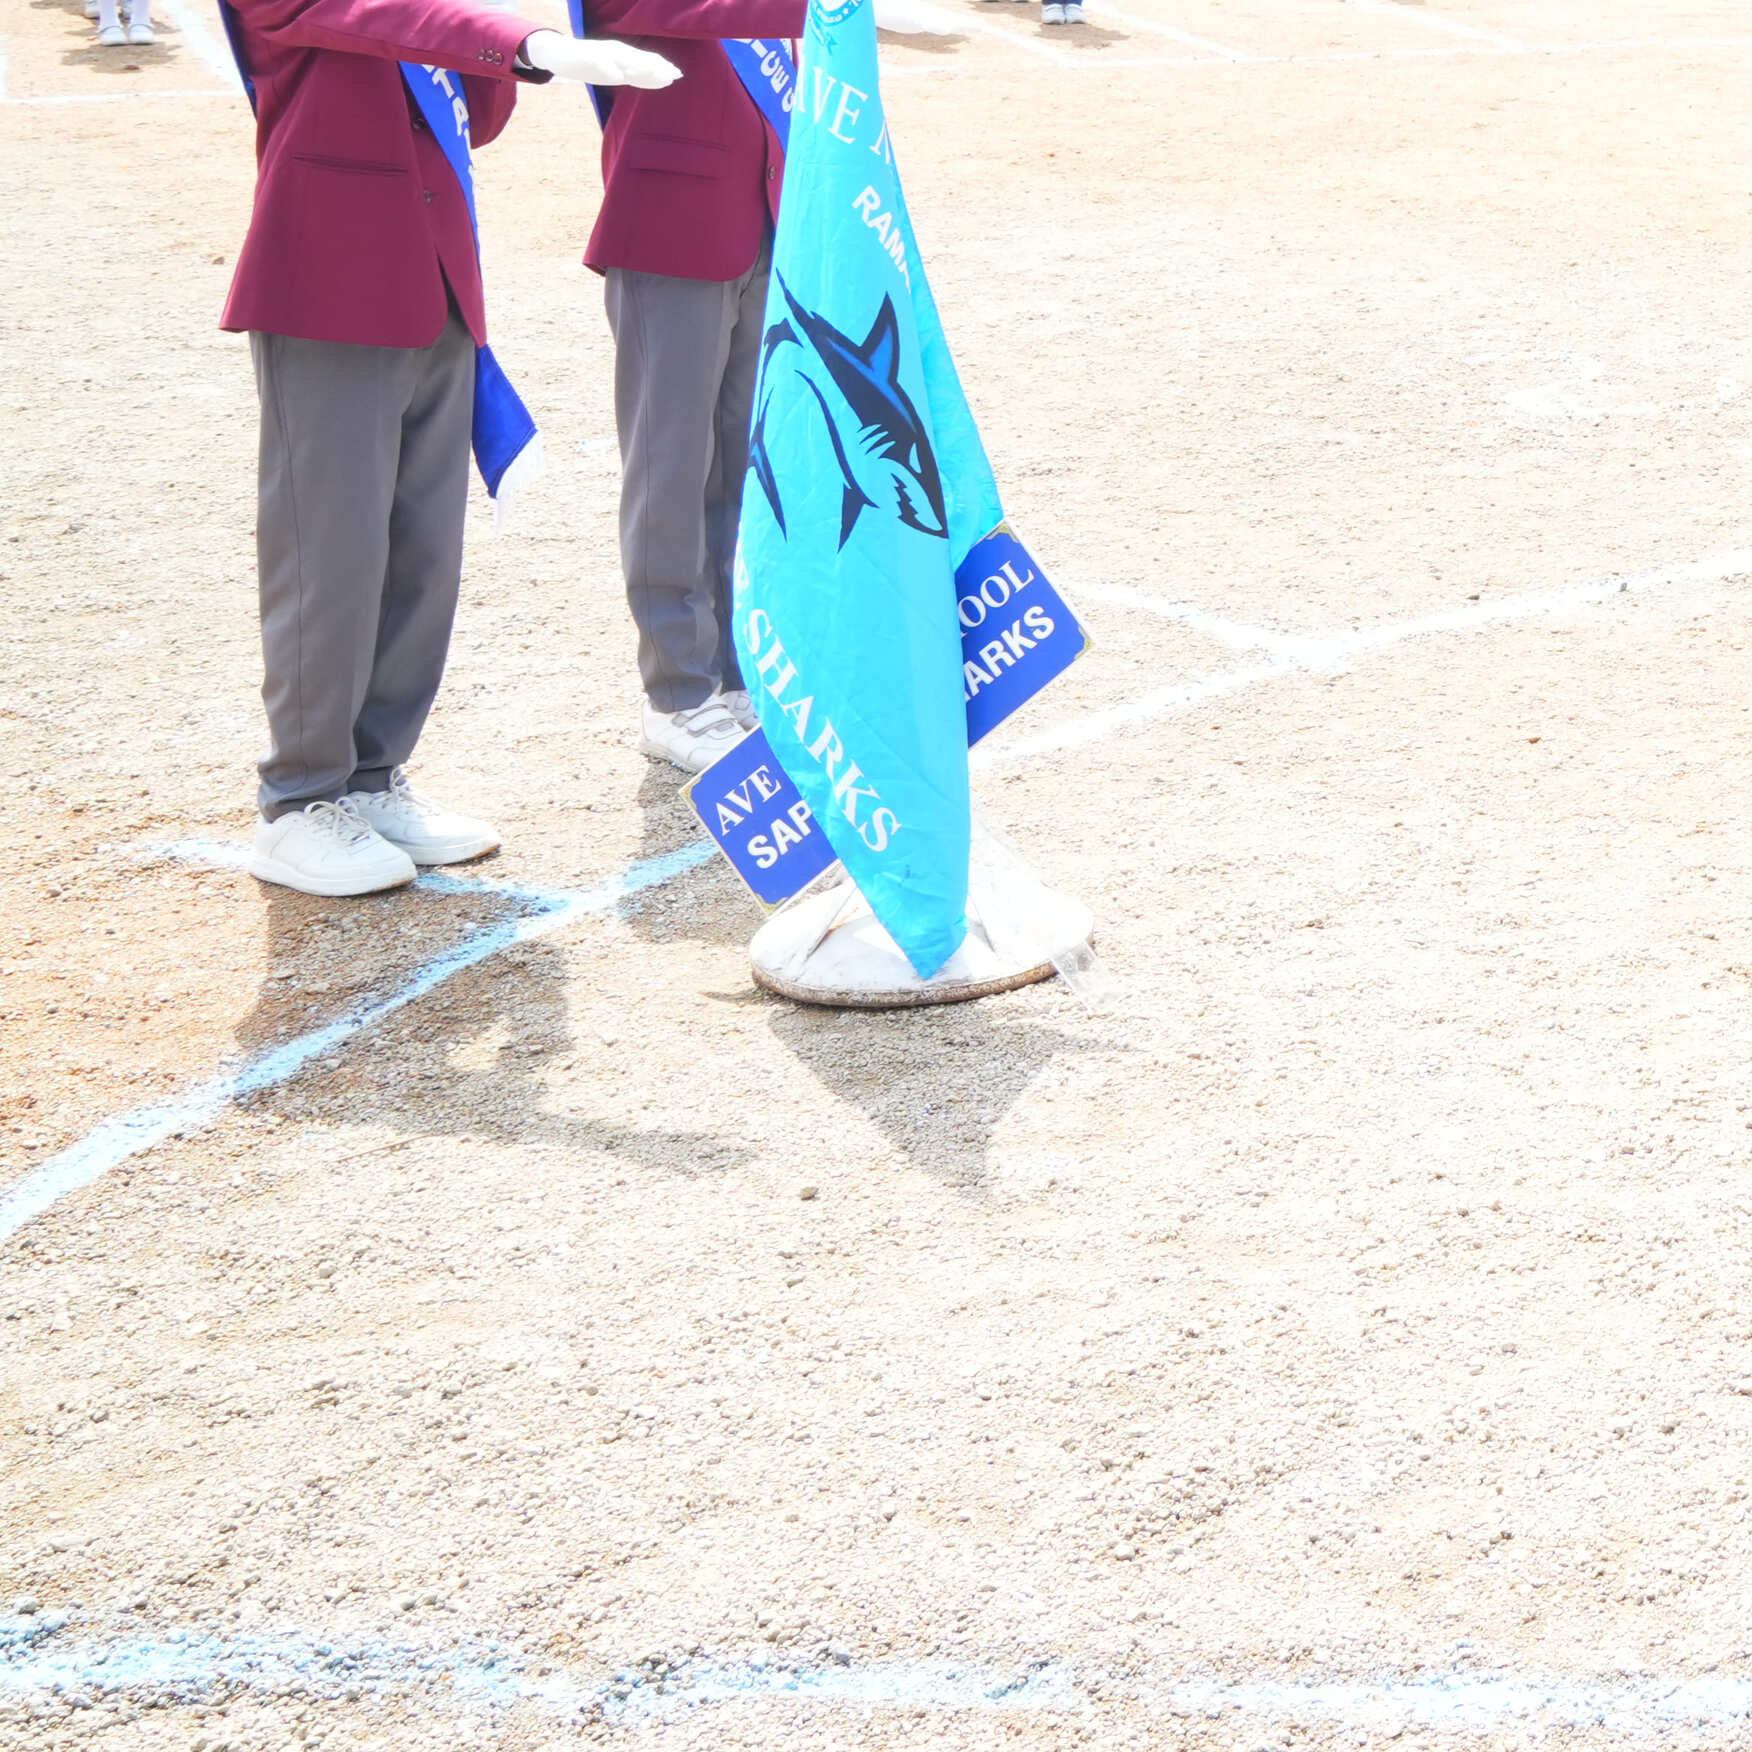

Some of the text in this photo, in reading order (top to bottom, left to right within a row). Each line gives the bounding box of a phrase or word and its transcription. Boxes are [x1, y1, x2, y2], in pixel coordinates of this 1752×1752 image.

[957, 560, 1035, 639] OOL
[963, 605, 1055, 703] ARKS
[744, 608, 902, 852] SHARKS
[715, 765, 782, 836] AVE
